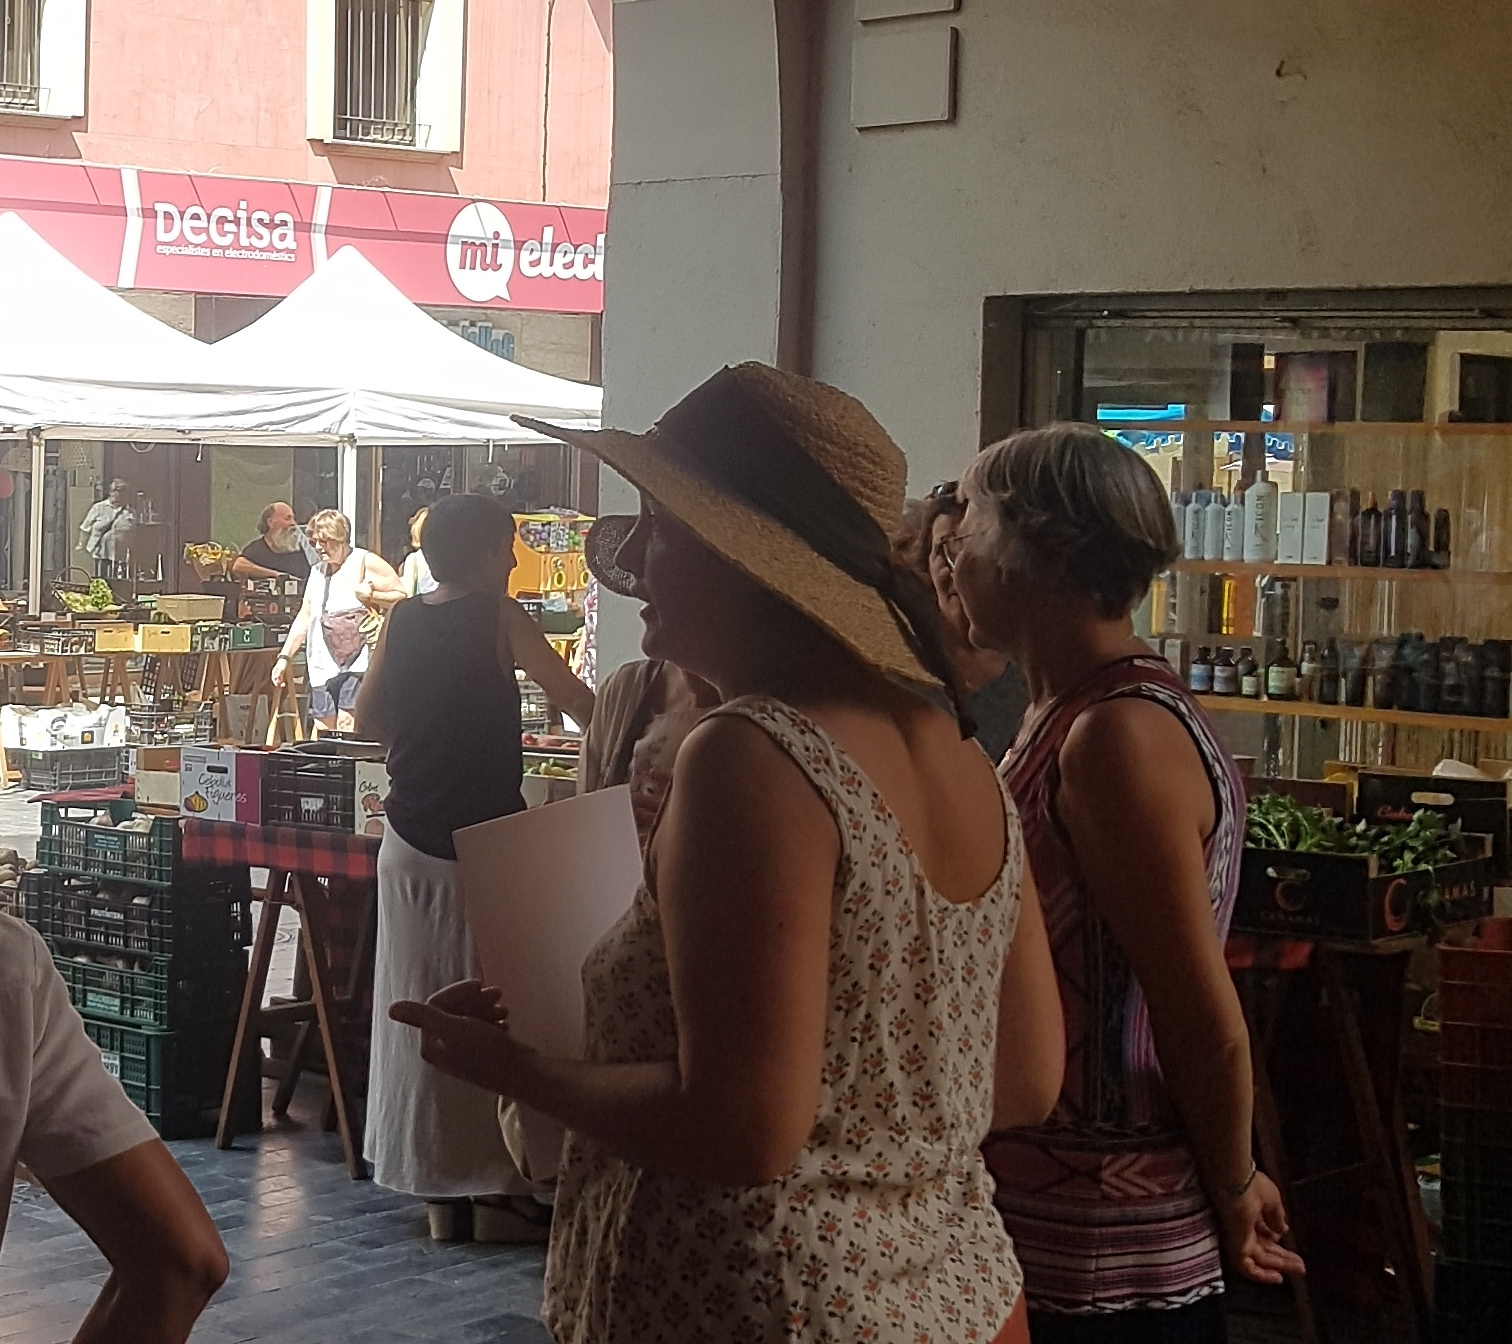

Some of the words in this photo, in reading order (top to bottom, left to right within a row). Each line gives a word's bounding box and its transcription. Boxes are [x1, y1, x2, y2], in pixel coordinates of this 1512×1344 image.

[153, 199, 298, 250] Decisa
[211, 247, 224, 258] en
[458, 230, 503, 272] mi
